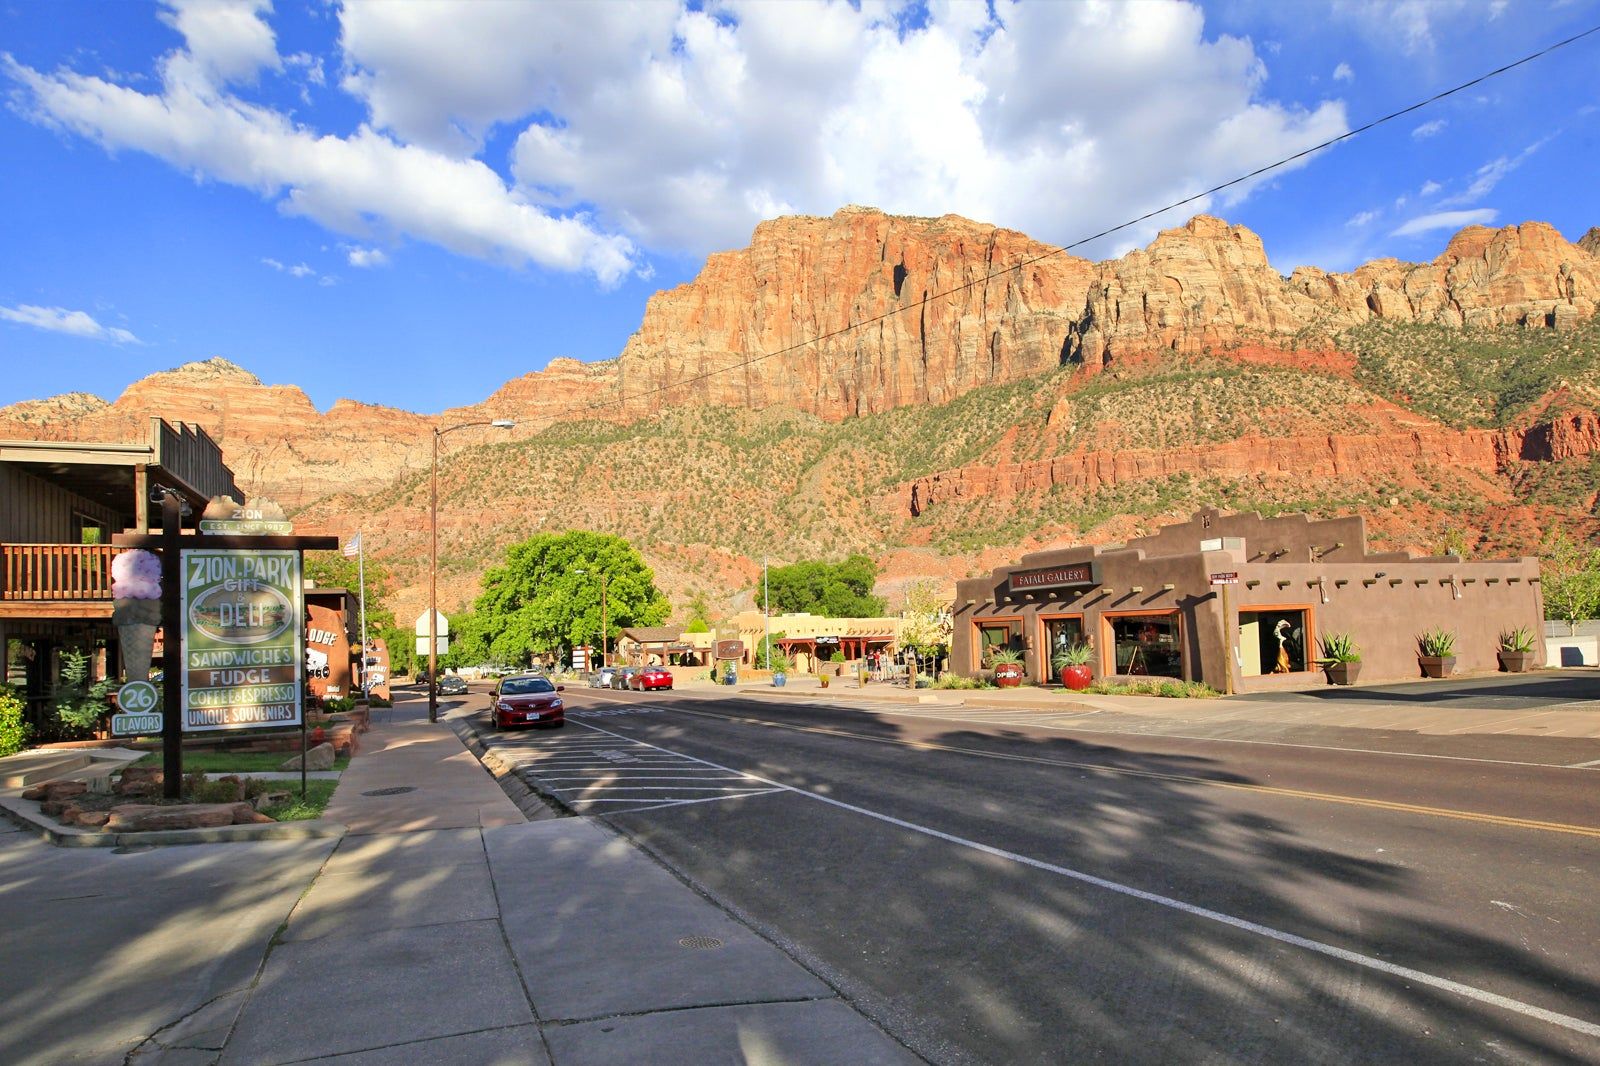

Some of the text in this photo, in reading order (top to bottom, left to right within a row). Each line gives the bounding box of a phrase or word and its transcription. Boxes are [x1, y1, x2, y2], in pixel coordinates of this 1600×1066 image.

[243, 556, 293, 590] PARK
[1019, 570, 1084, 585] FATALI GALLERY
[223, 578, 260, 592] GIFT
[220, 602, 264, 627] DELI
[190, 648, 291, 667] SANDWICHES
[210, 668, 271, 686] FUDGE
[124, 688, 152, 708] 26
[116, 716, 160, 731] FLAVORS
[189, 704, 292, 725] UNIQUE SOUVENIRS
